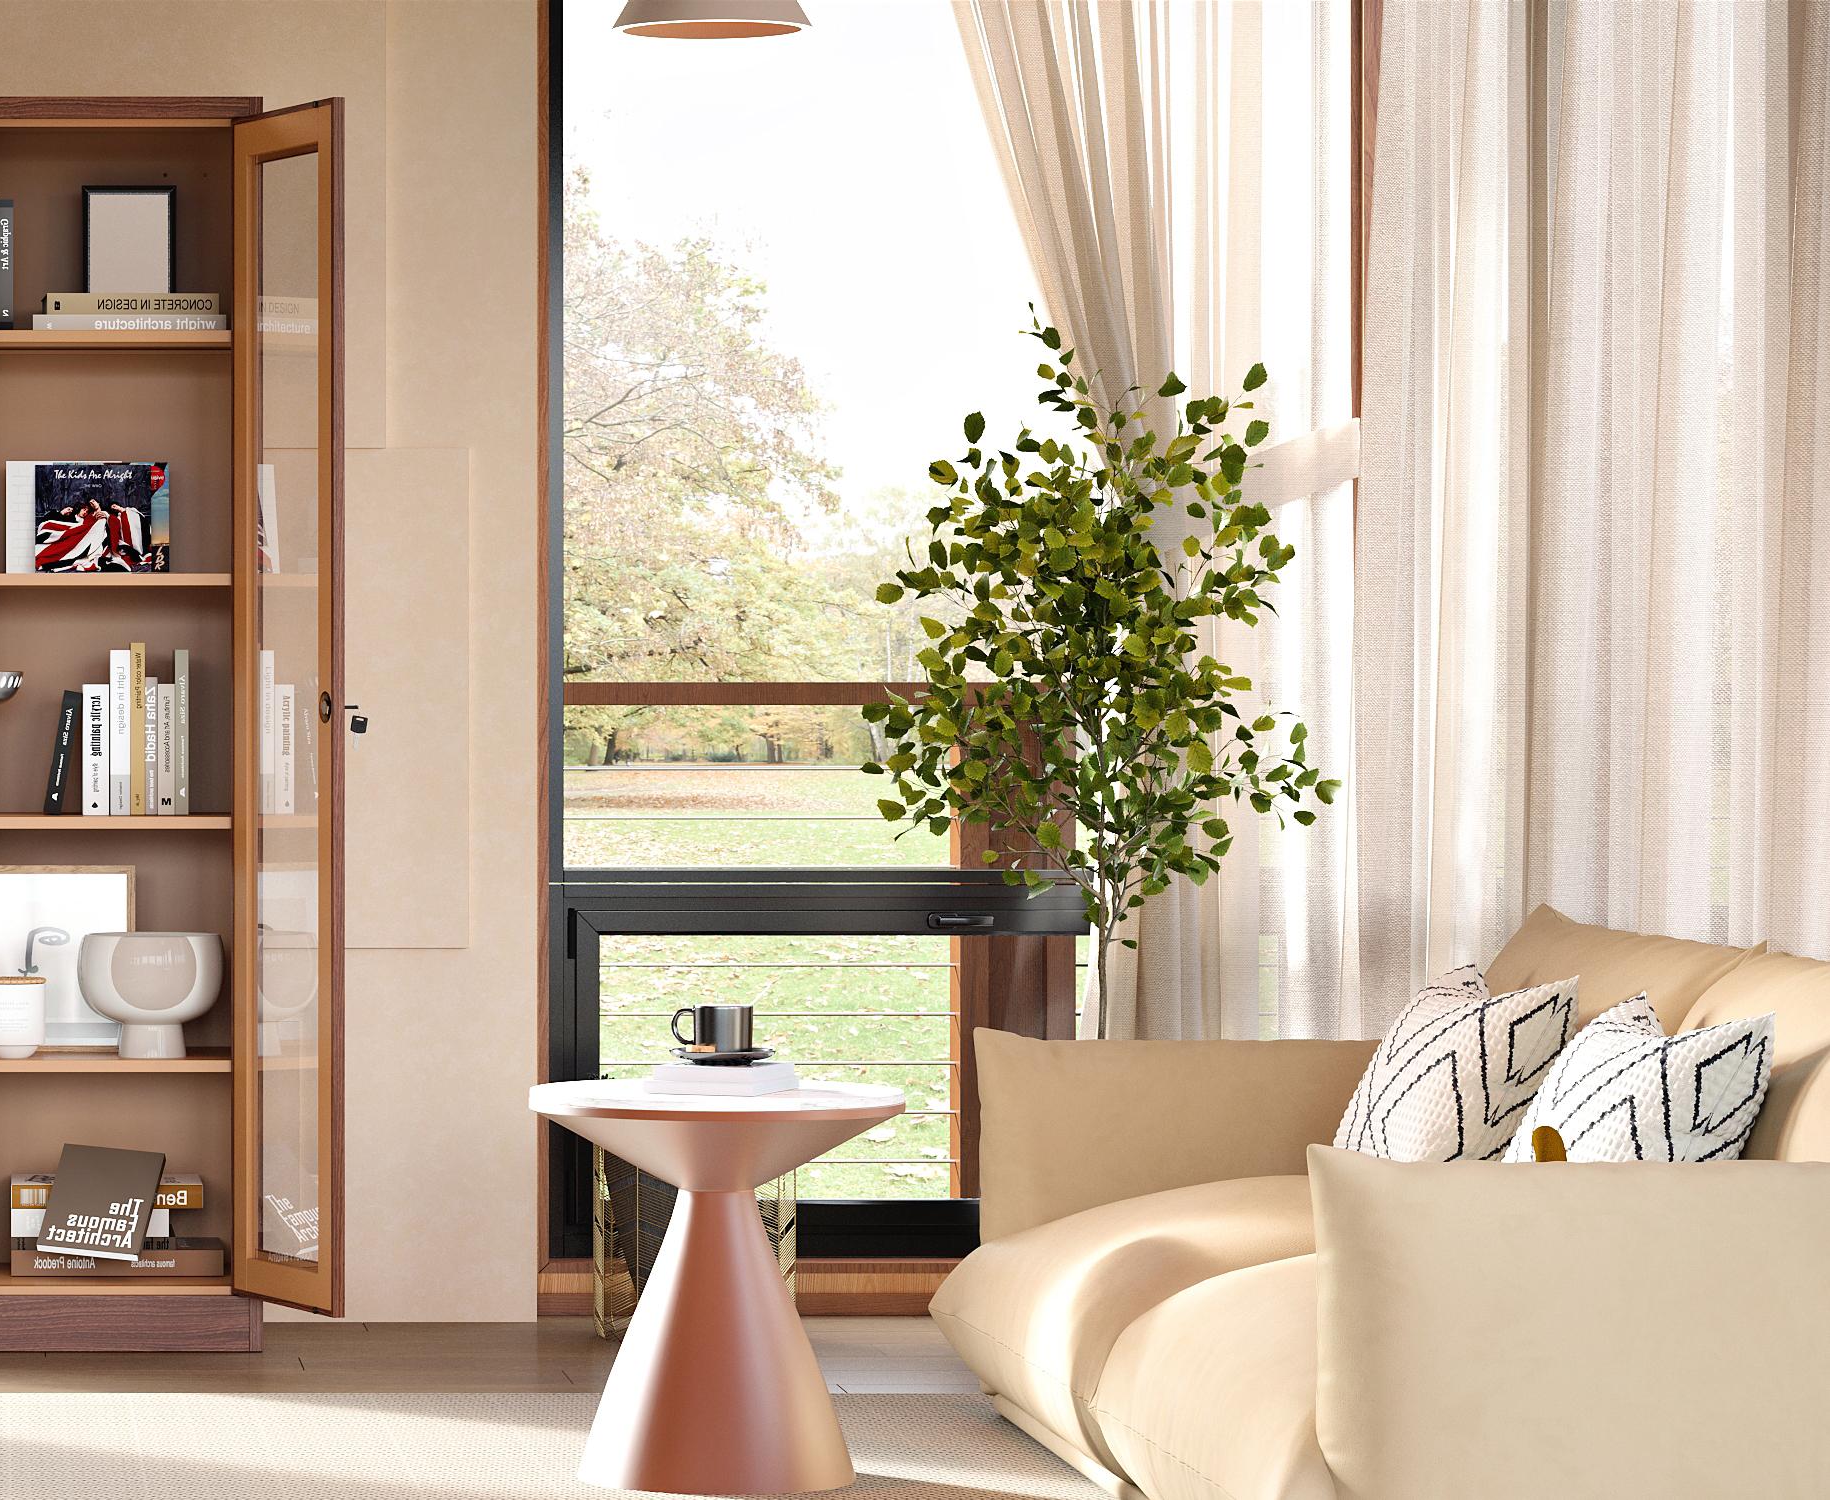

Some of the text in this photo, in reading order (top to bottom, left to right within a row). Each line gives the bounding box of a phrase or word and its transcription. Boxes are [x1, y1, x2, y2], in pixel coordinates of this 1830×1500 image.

[54, 470, 66, 479] The
[68, 470, 87, 479] Kids
[88, 470, 101, 479] Are
